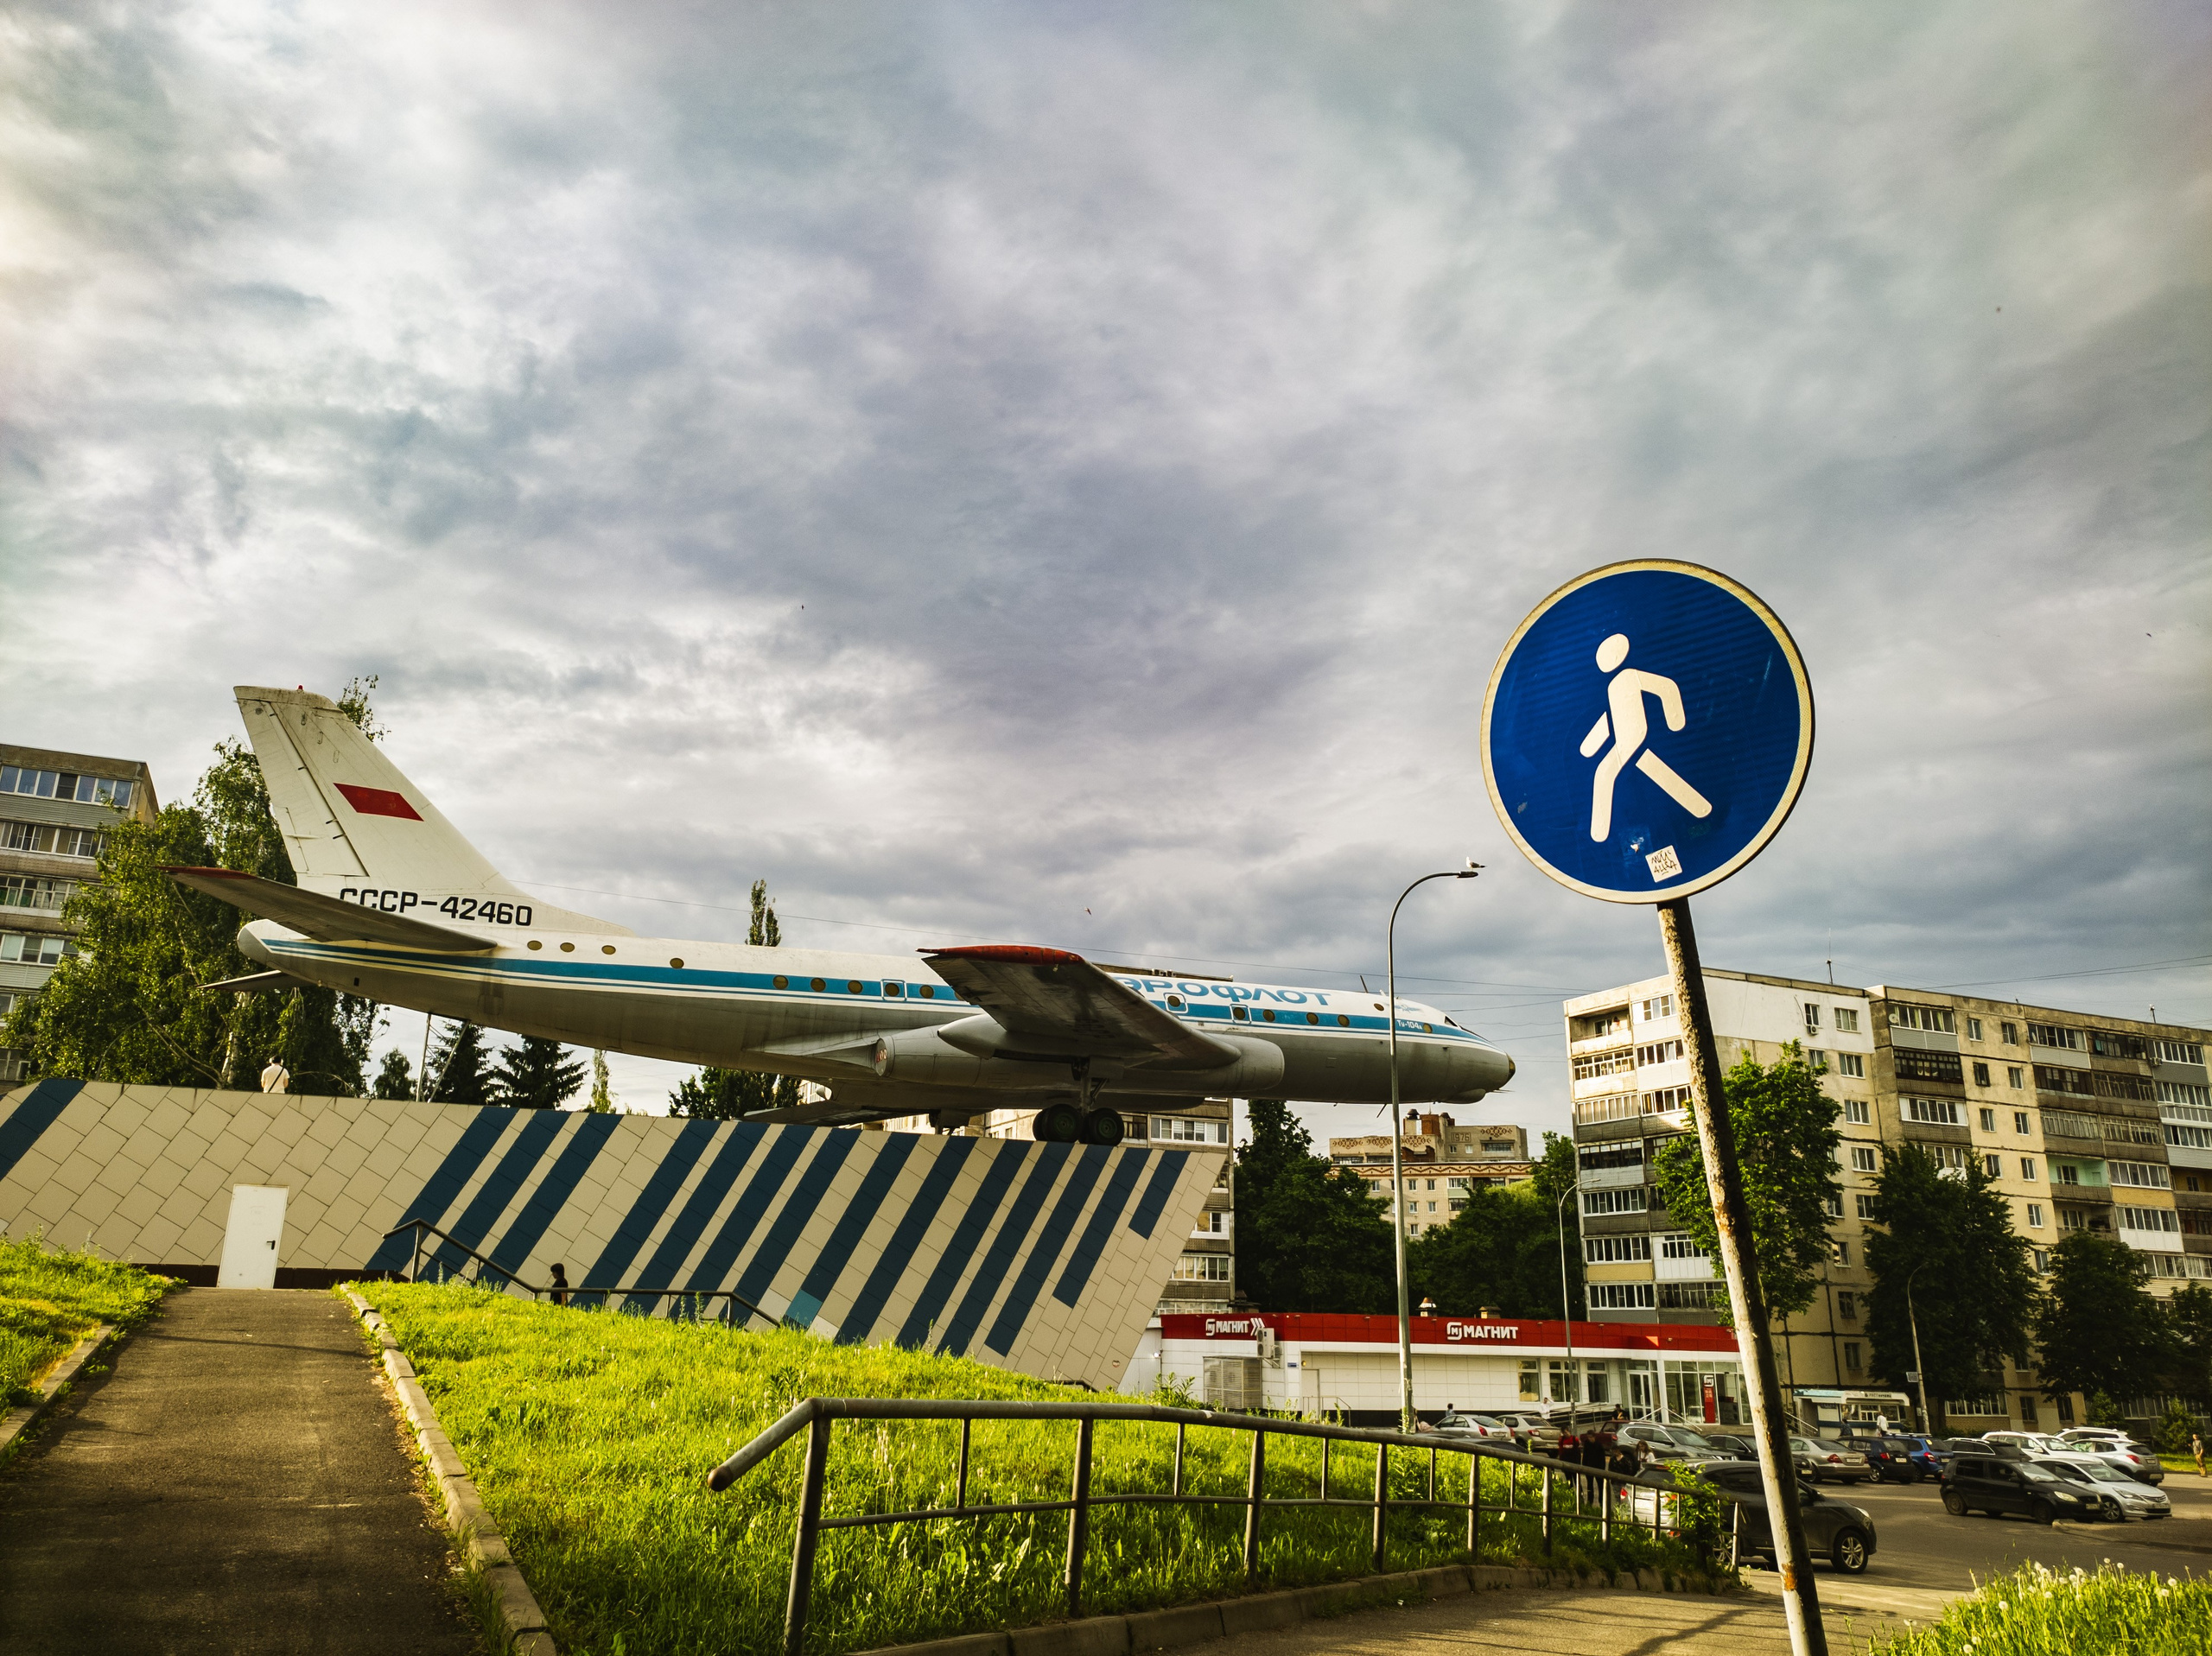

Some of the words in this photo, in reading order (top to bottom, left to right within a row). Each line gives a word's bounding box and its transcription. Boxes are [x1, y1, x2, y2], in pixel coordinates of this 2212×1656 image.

[1112, 976, 1332, 1006] ЭРОФЛОТ
[1452, 1133, 1470, 1141] 1976
[1216, 1320, 1250, 1333] МАГНИТ
[1463, 1324, 1519, 1339] МАГНИТ
